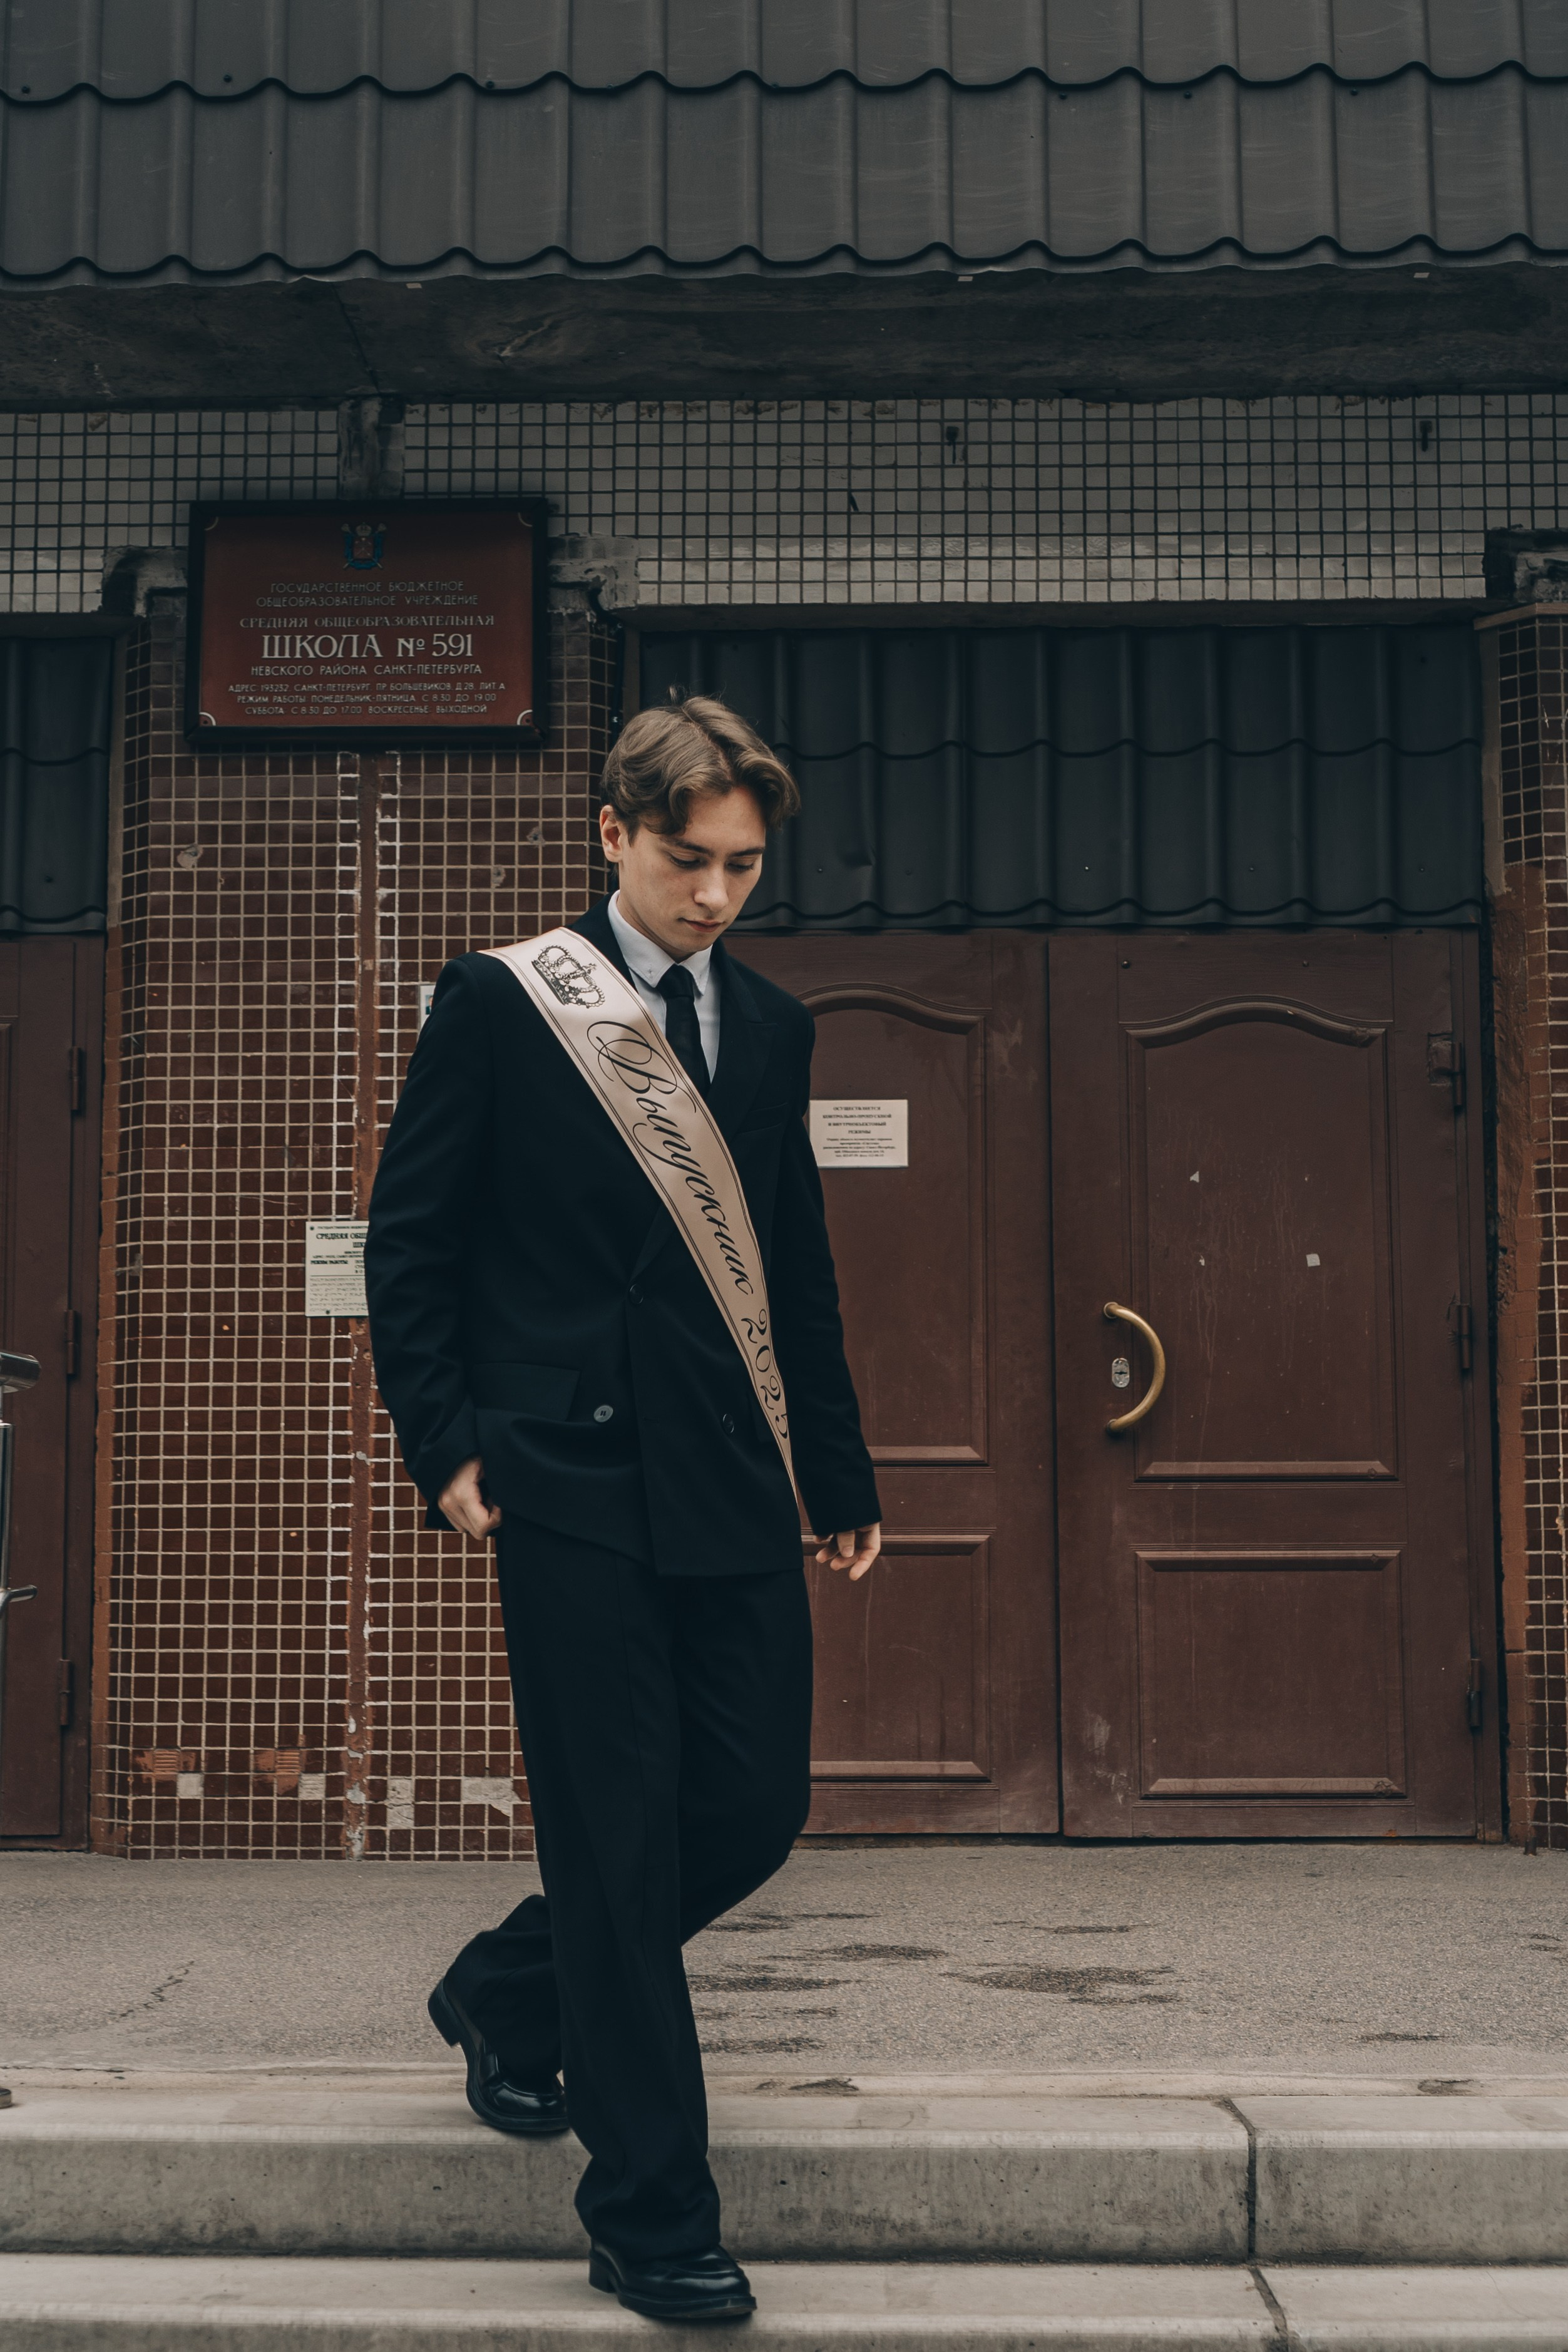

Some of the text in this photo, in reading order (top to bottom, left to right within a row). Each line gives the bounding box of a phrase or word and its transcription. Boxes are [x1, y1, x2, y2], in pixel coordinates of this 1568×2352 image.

[270, 580, 464, 593] ГОСУДАРСТВЕННОЕ БЮДЖЕТНОЕ
[256, 595, 478, 607] ОБЩЕОБРАЗОВАТЕЛЬНОЕ УЧРЕЖДЕНИЕ
[240, 615, 494, 629] СРЕДНЯЯ ОБЩЕОБРАЗОВАТЕЛЬНАЯ
[261, 633, 474, 659] ШКОЛА № 591
[251, 663, 483, 676] НЕВСКОГО РАЙОНА САНКТ-ПЕТЕРБУРГА
[237, 695, 269, 703] РЕЖИМ
[454, 694, 469, 702] ДО
[322, 706, 337, 714] ДО
[436, 704, 488, 714] ВЫХОДНОЙ
[587, 1020, 788, 1439] Выпускник 2025
